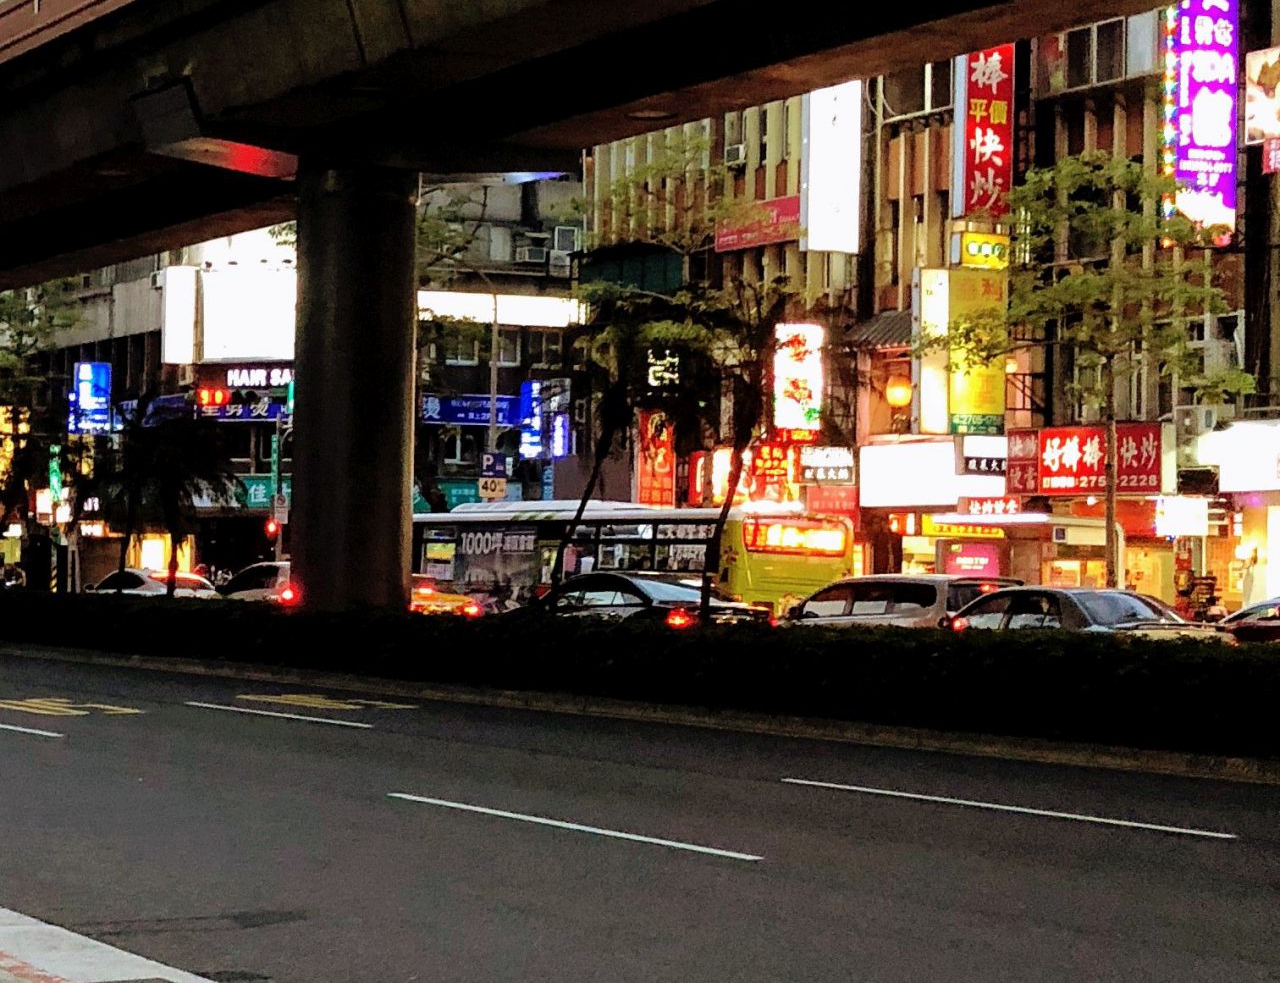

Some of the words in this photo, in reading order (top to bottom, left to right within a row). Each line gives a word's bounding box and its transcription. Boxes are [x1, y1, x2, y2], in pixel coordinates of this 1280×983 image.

[227, 369, 268, 387] HAIR
[270, 368, 295, 387] SA
[482, 454, 494, 470] P
[481, 480, 497, 493] 40
[1079, 474, 1158, 488] 275-2228
